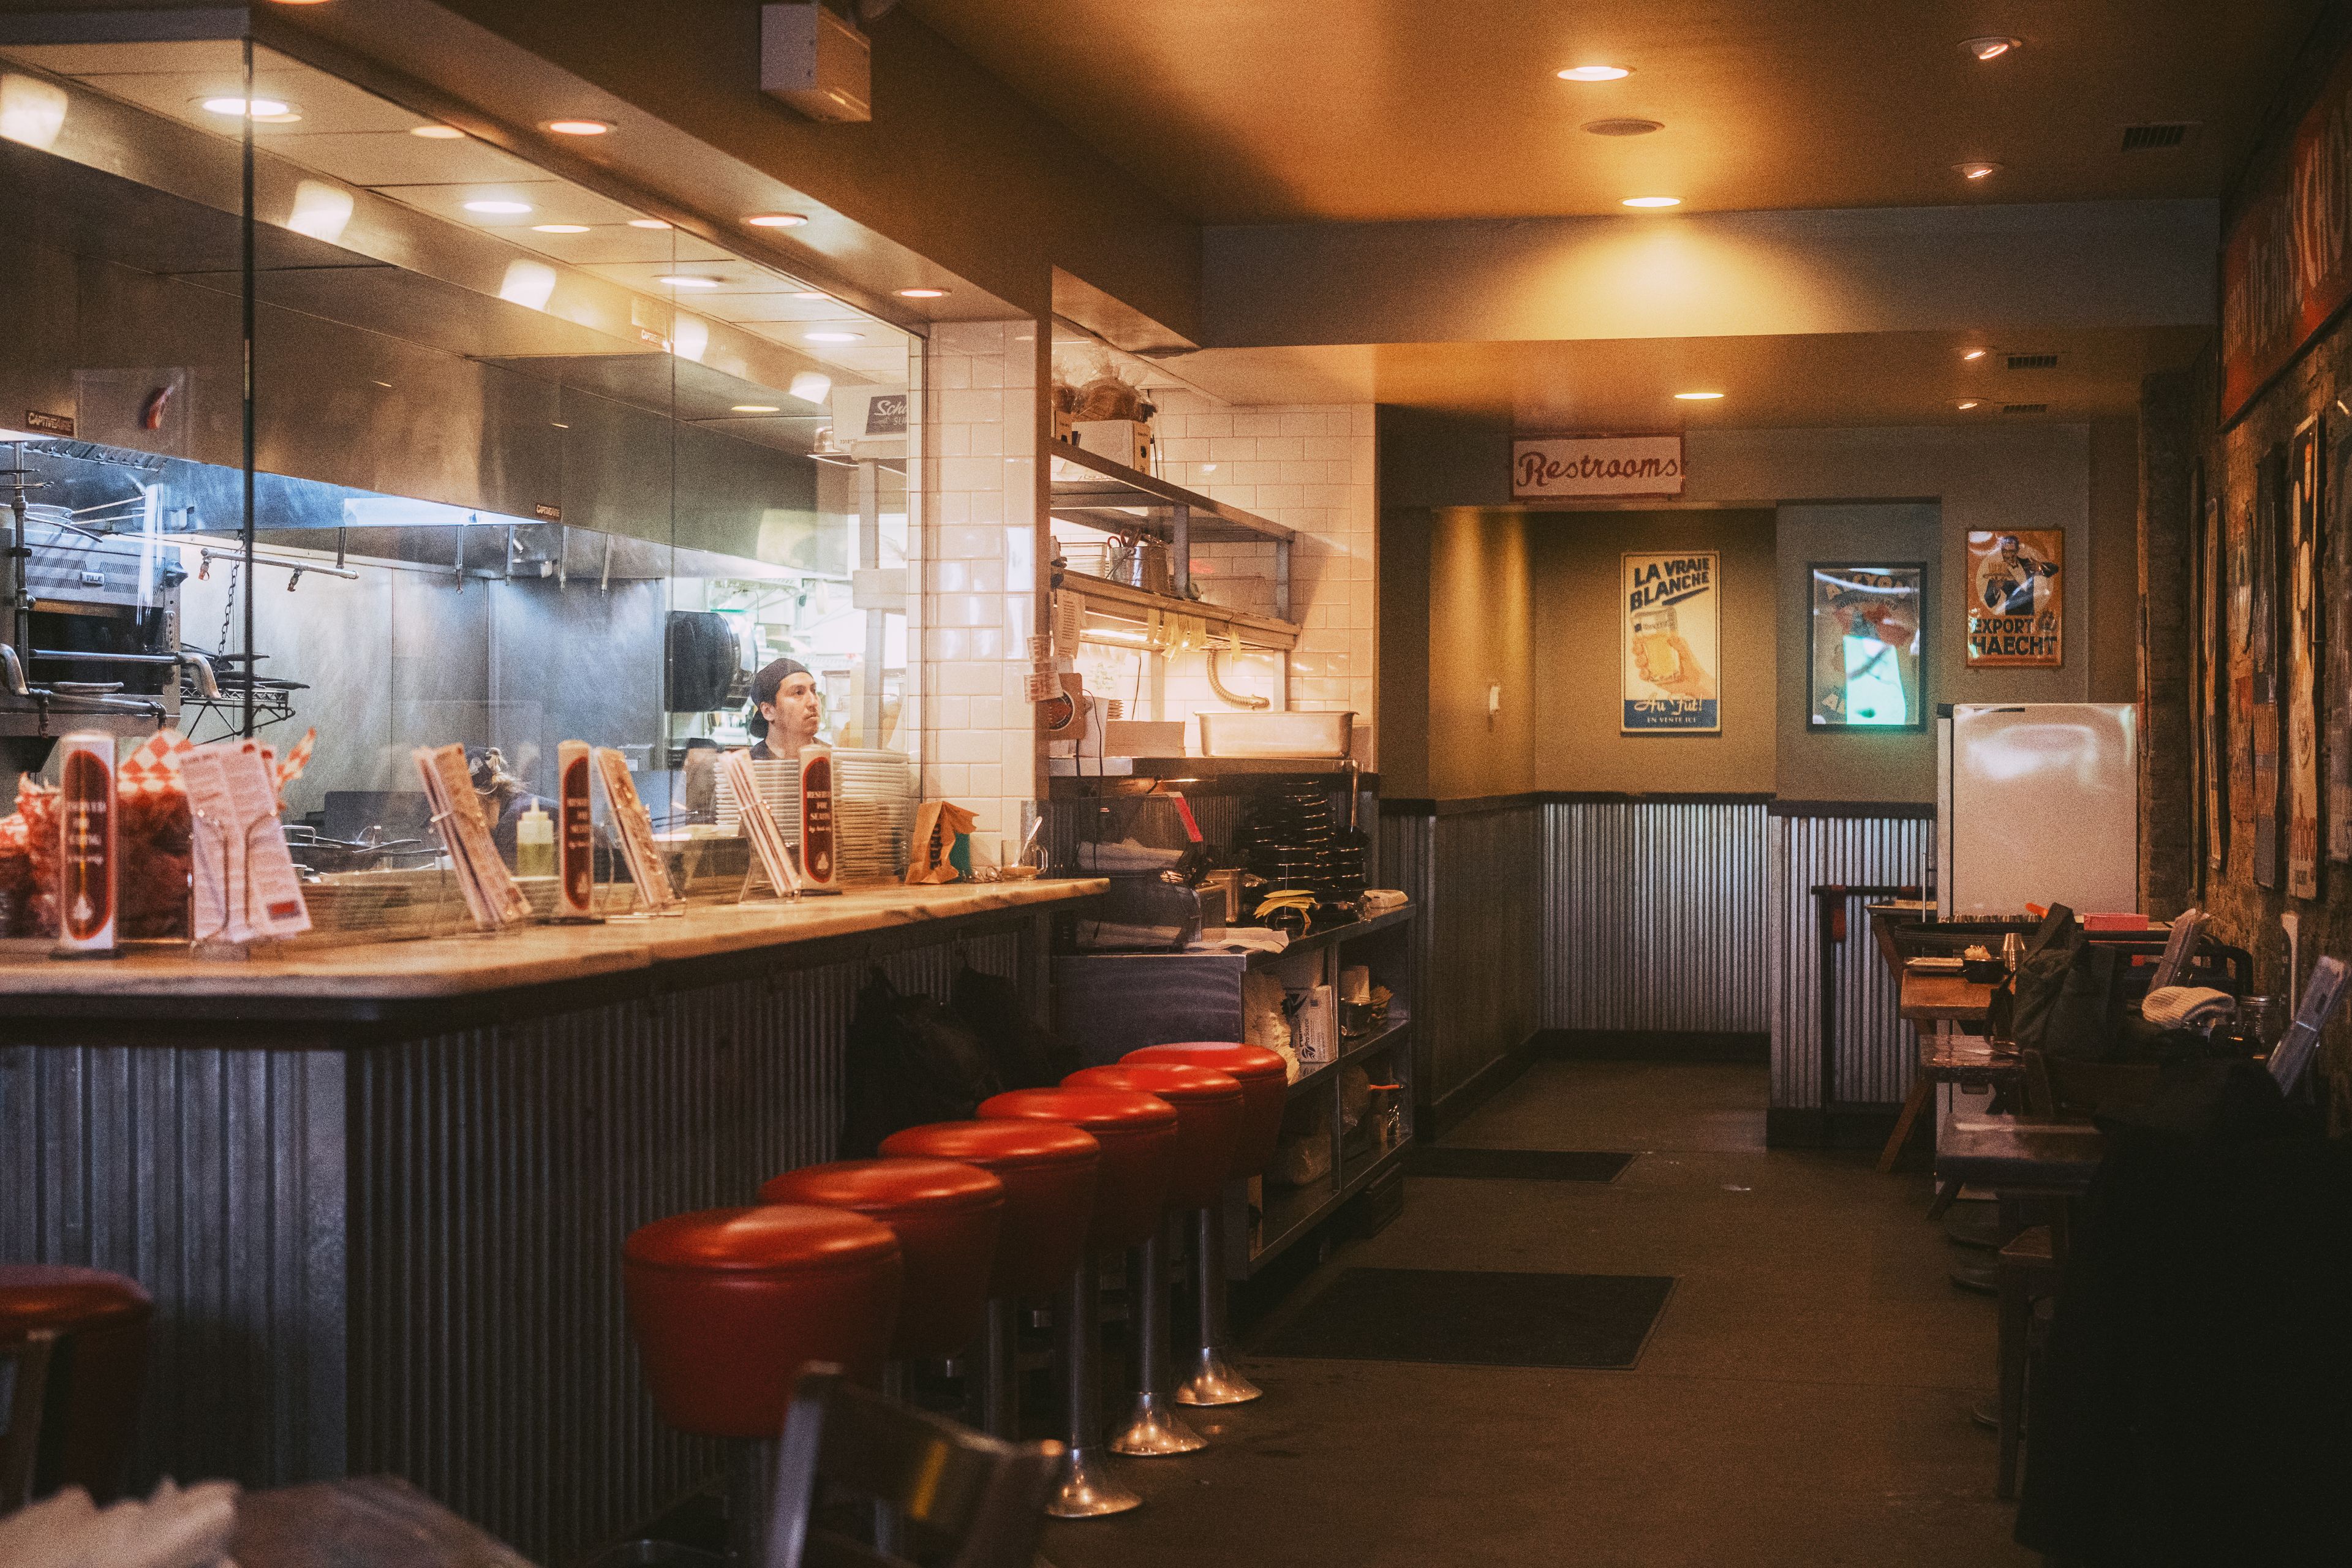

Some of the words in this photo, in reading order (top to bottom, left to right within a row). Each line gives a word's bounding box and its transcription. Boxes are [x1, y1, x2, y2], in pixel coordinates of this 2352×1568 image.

[1516, 451, 1678, 488] Restrooms
[1634, 563, 1661, 589] LA
[1664, 557, 1709, 577] VRAIE
[1630, 571, 1709, 612] BLANCHE
[1972, 618, 2034, 634] EXPORT
[1972, 636, 2057, 655] HAECHT
[1634, 692, 1666, 714] Au
